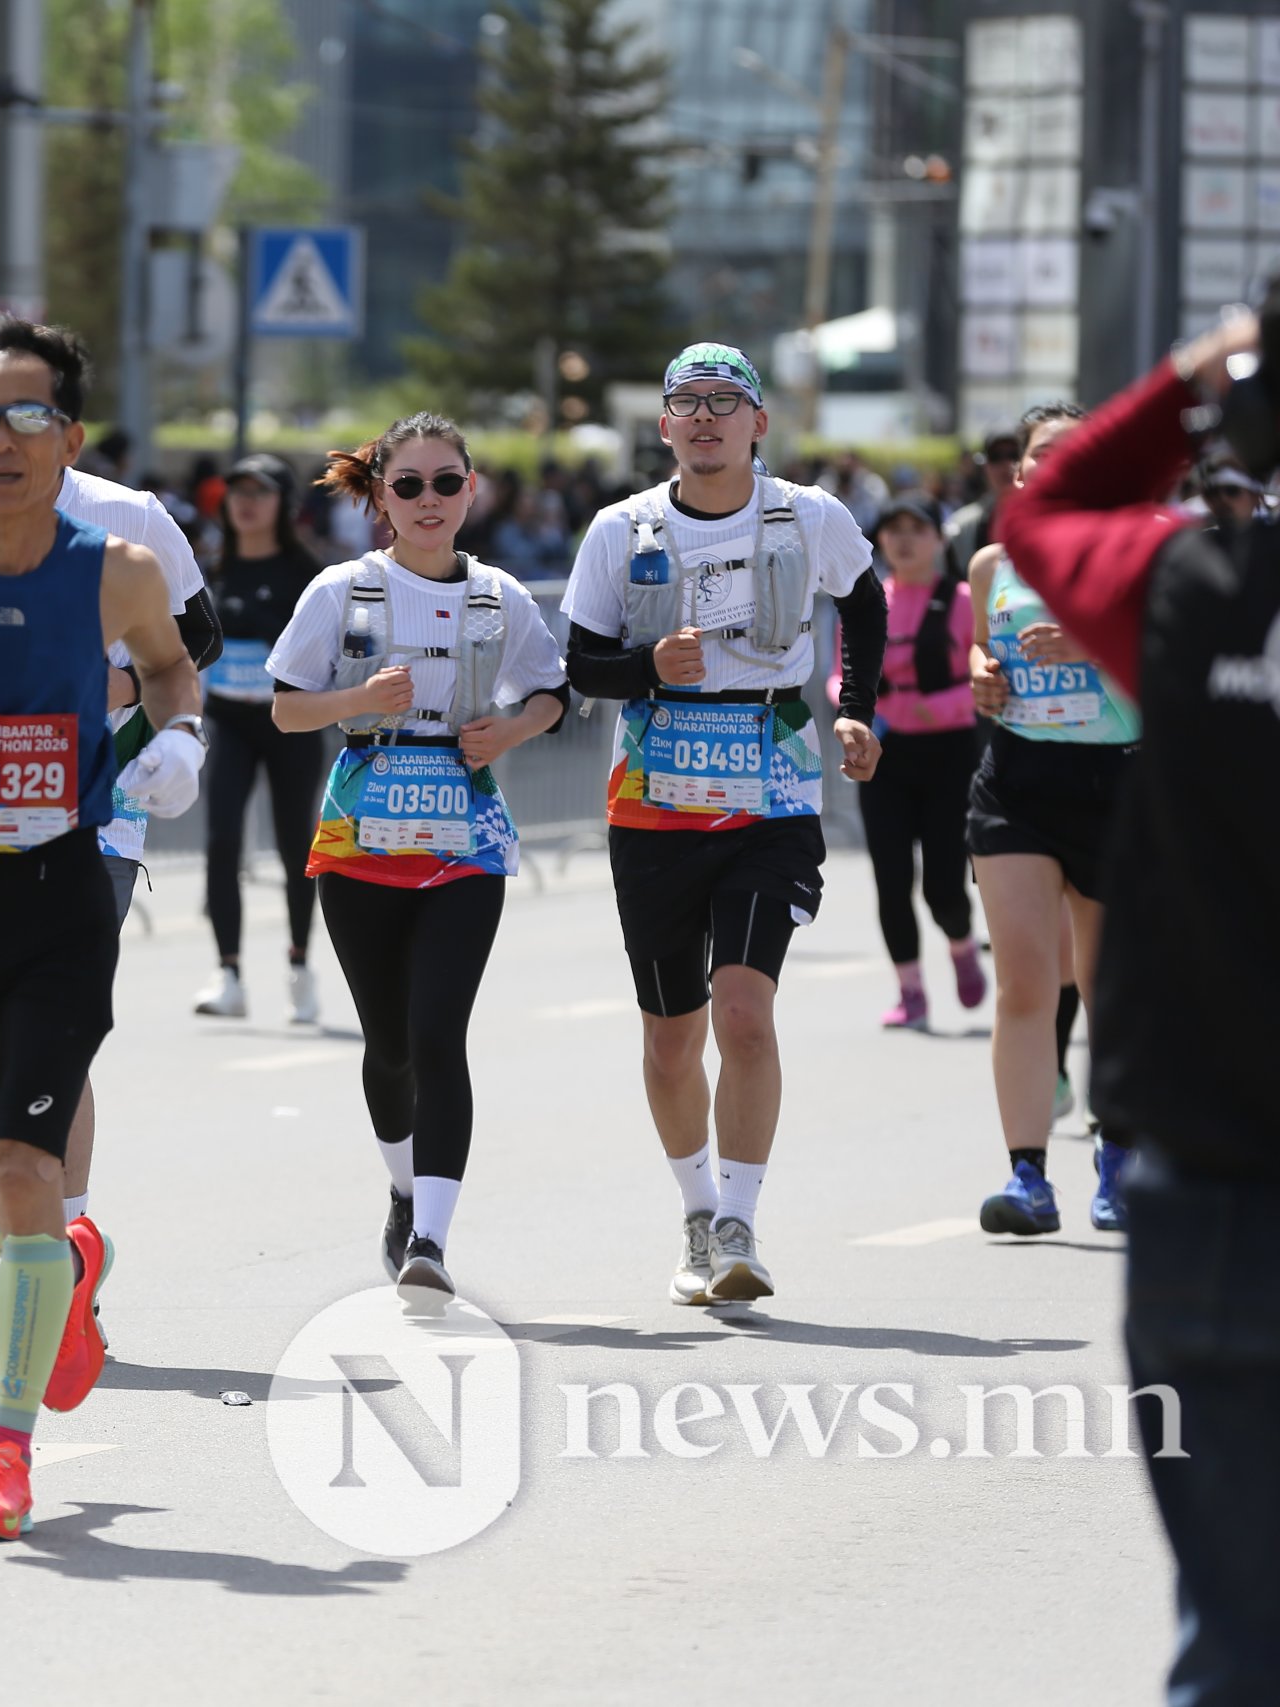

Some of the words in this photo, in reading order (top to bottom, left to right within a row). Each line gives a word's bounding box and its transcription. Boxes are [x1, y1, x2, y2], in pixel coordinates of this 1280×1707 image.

[674, 710, 754, 723] ULAANBAATAR
[674, 722, 738, 734] MARATHON
[35, 738, 69, 751] 2026
[390, 755, 456, 766] ULAANBAATAR
[674, 740, 761, 772] 03499
[392, 766, 446, 776] MARATHON
[447, 768, 466, 777] 2026
[387, 784, 468, 815] 03500
